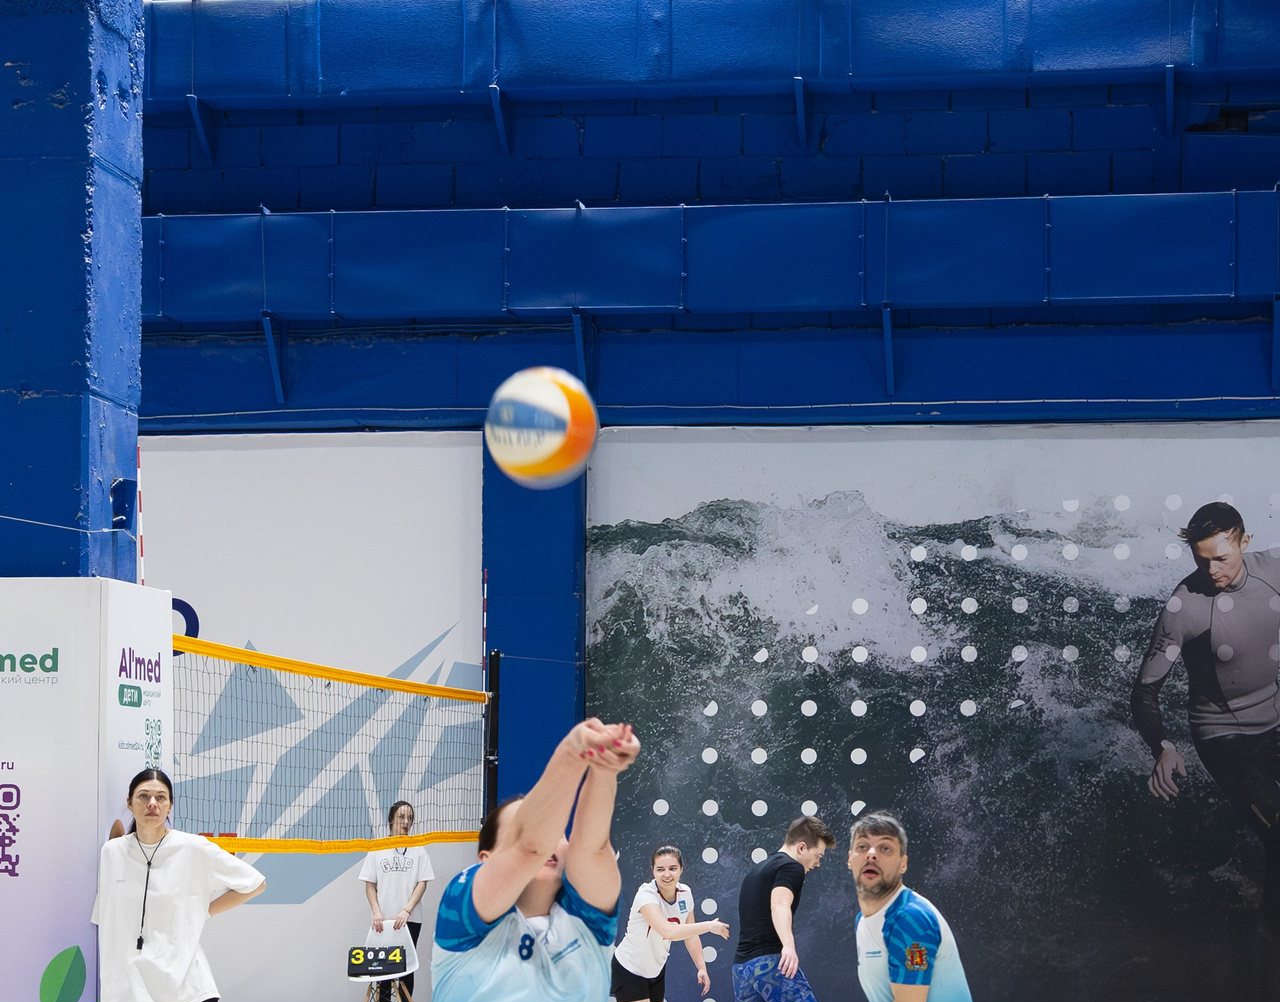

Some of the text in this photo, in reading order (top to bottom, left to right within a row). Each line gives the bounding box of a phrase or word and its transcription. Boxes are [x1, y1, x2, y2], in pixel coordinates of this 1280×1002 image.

[118, 647, 161, 683] Al'med
[24, 676, 59, 686] центр
[380, 857, 414, 873] GAP
[519, 933, 535, 961] 8
[350, 948, 402, 965] 3 0 0 4
